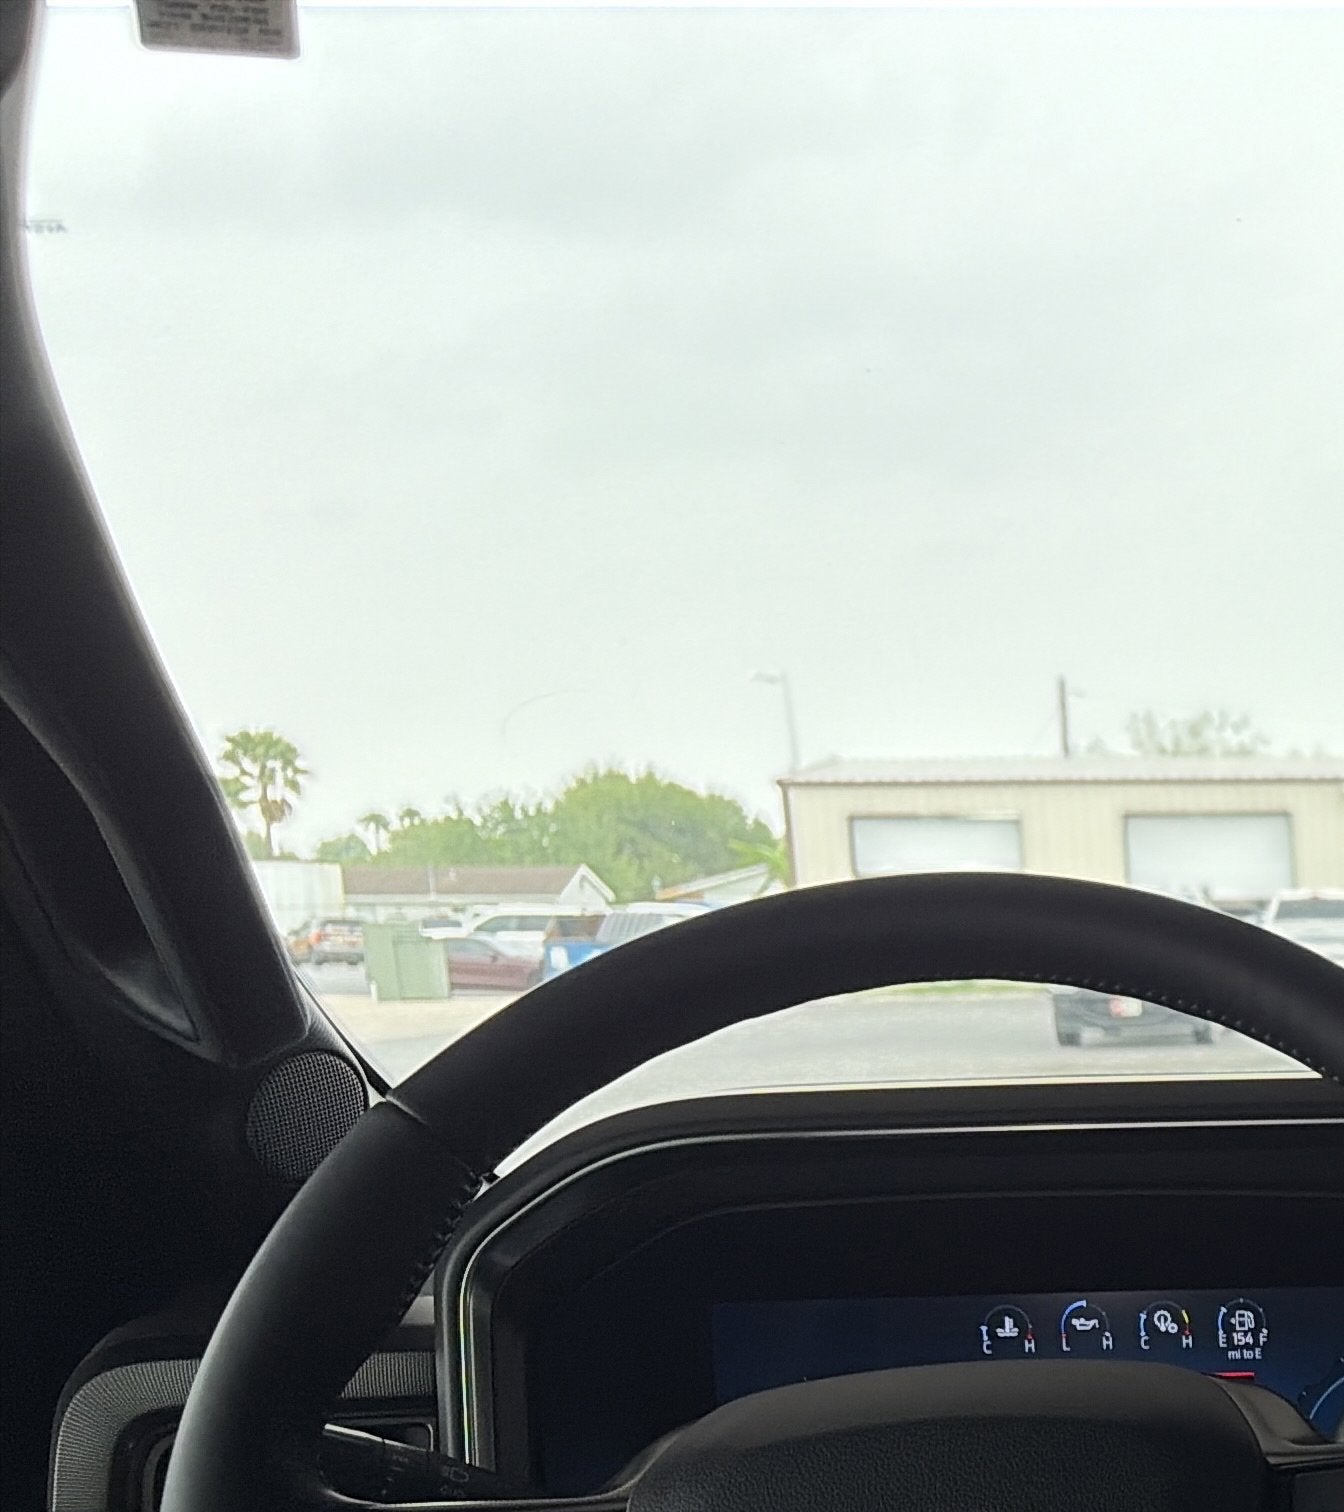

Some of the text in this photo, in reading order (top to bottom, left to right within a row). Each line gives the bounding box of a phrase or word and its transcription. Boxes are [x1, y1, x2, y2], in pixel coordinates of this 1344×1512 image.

[1182, 1335, 1192, 1349] H
[1233, 1332, 1253, 1345] 154
[1228, 1348, 1262, 1359] mi to E
